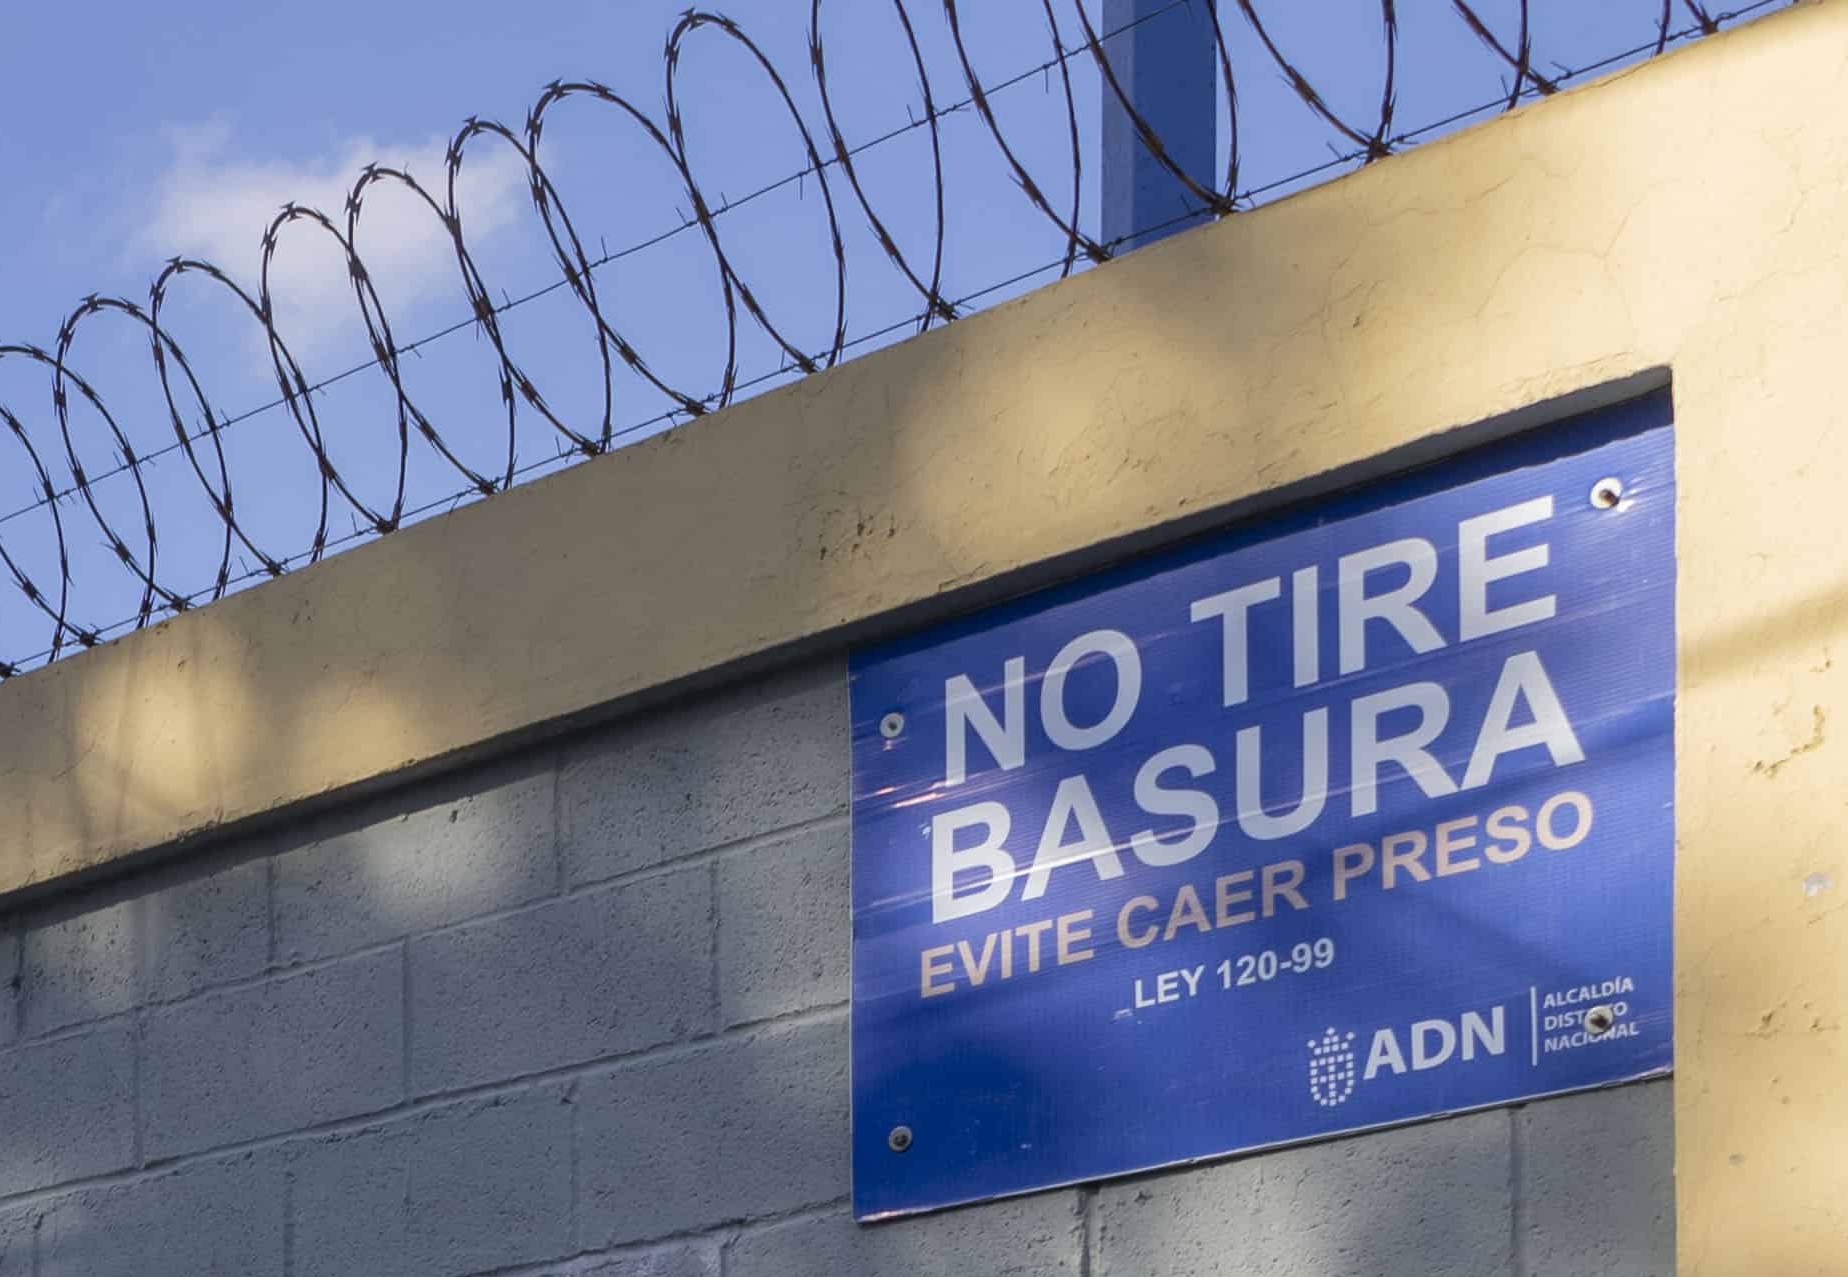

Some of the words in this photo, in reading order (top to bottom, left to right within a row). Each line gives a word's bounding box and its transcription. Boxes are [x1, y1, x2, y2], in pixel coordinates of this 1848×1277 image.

[944, 628, 1142, 788] NO
[1190, 495, 1557, 709] TIRE
[930, 650, 1586, 925] BASURA
[921, 909, 1095, 999] EVITE
[1117, 860, 1306, 951] CAER
[1332, 791, 1594, 902] PRESO
[1134, 963, 1204, 1011] LEY
[1216, 937, 1337, 990] 120-99
[1543, 975, 1635, 1009] ALCALDÍA
[1363, 1005, 1505, 1081] ADN
[1544, 1001, 1628, 1031] DISTO
